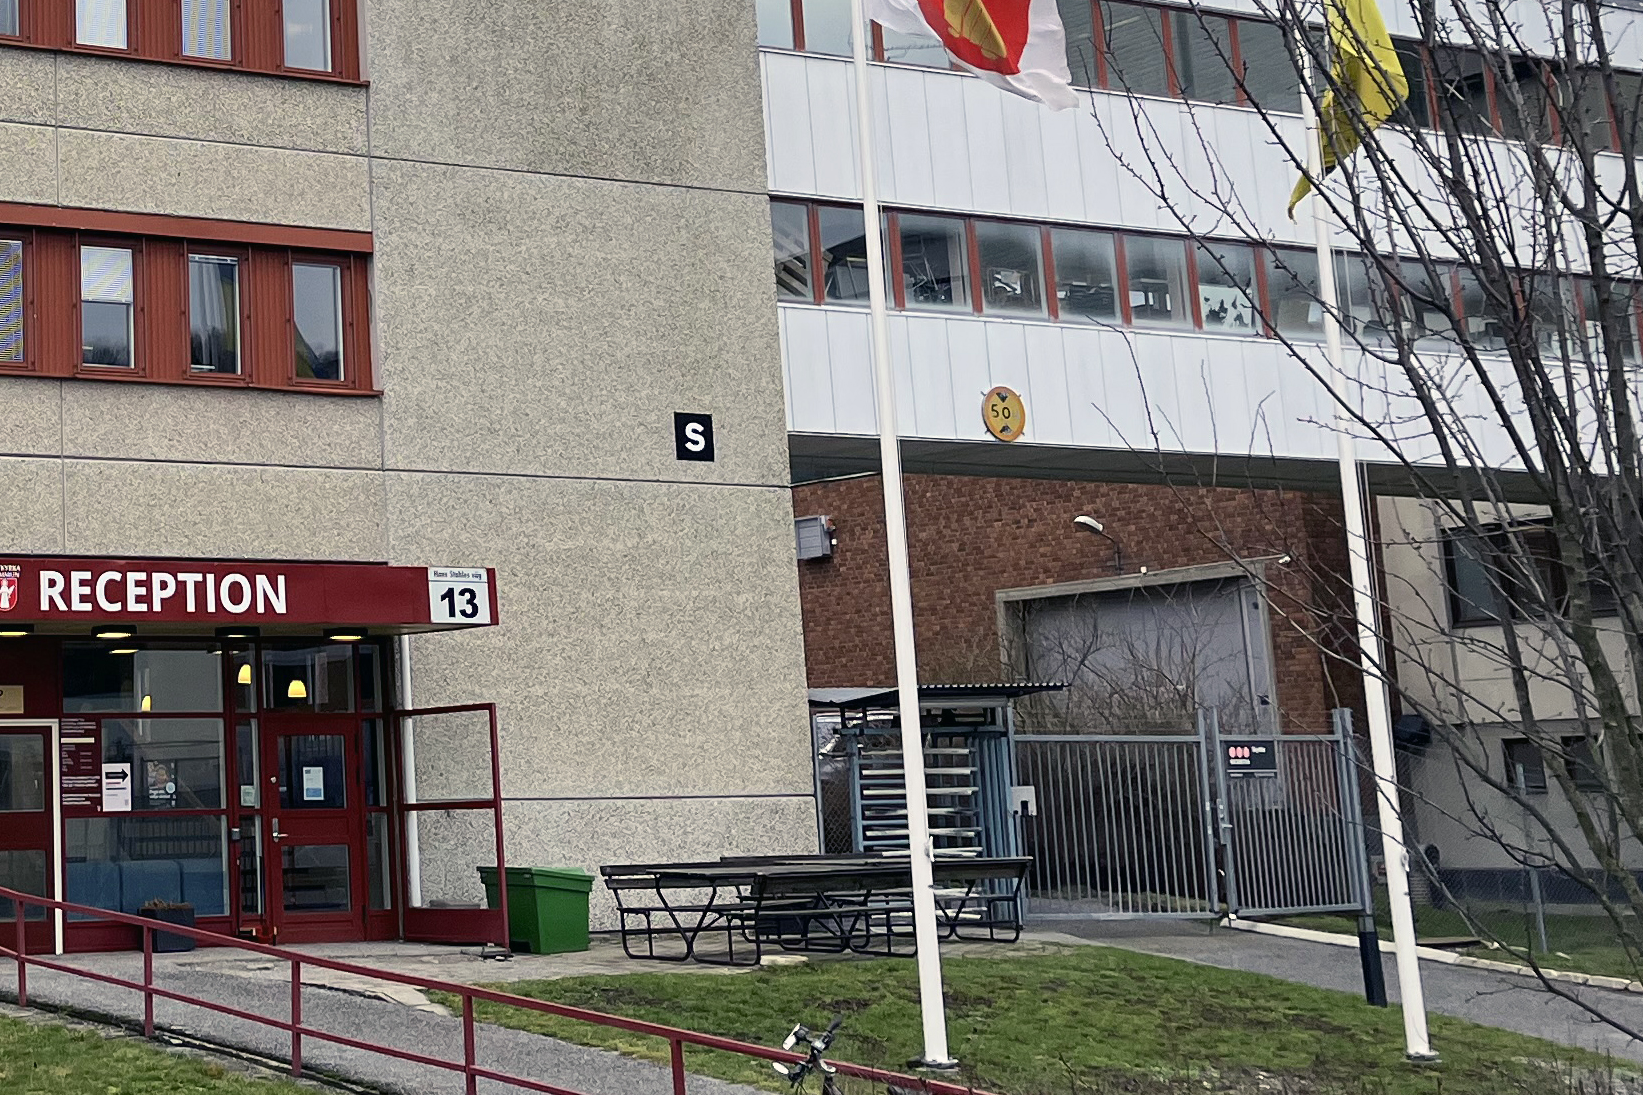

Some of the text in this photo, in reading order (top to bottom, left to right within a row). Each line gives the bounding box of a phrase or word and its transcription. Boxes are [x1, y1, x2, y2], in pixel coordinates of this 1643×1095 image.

[684, 421, 706, 452] S
[39, 570, 288, 615] RECEPTION
[440, 587, 479, 619] 13
